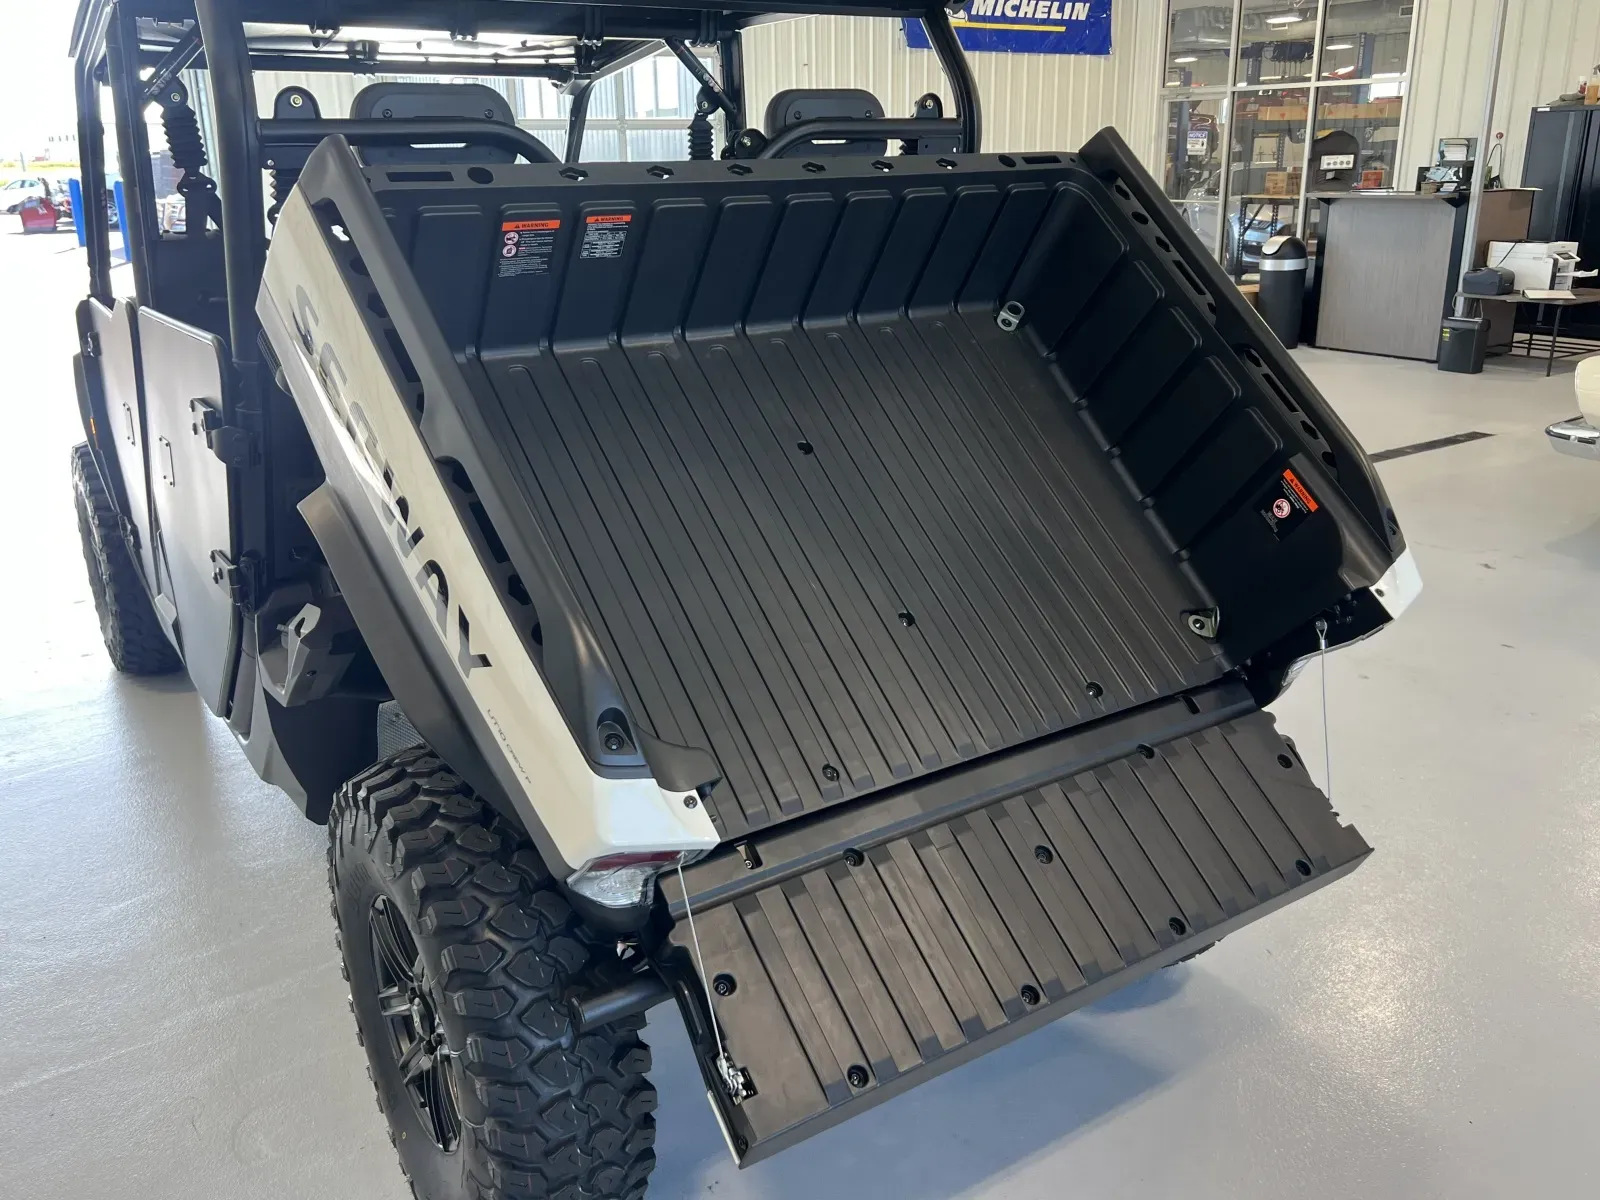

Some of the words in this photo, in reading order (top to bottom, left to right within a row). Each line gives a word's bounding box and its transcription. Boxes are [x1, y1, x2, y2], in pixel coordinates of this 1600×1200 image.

[971, 0, 1090, 20] MICHELIN
[1294, 483, 1312, 504] WARNING
[506, 744, 525, 773] CREW
